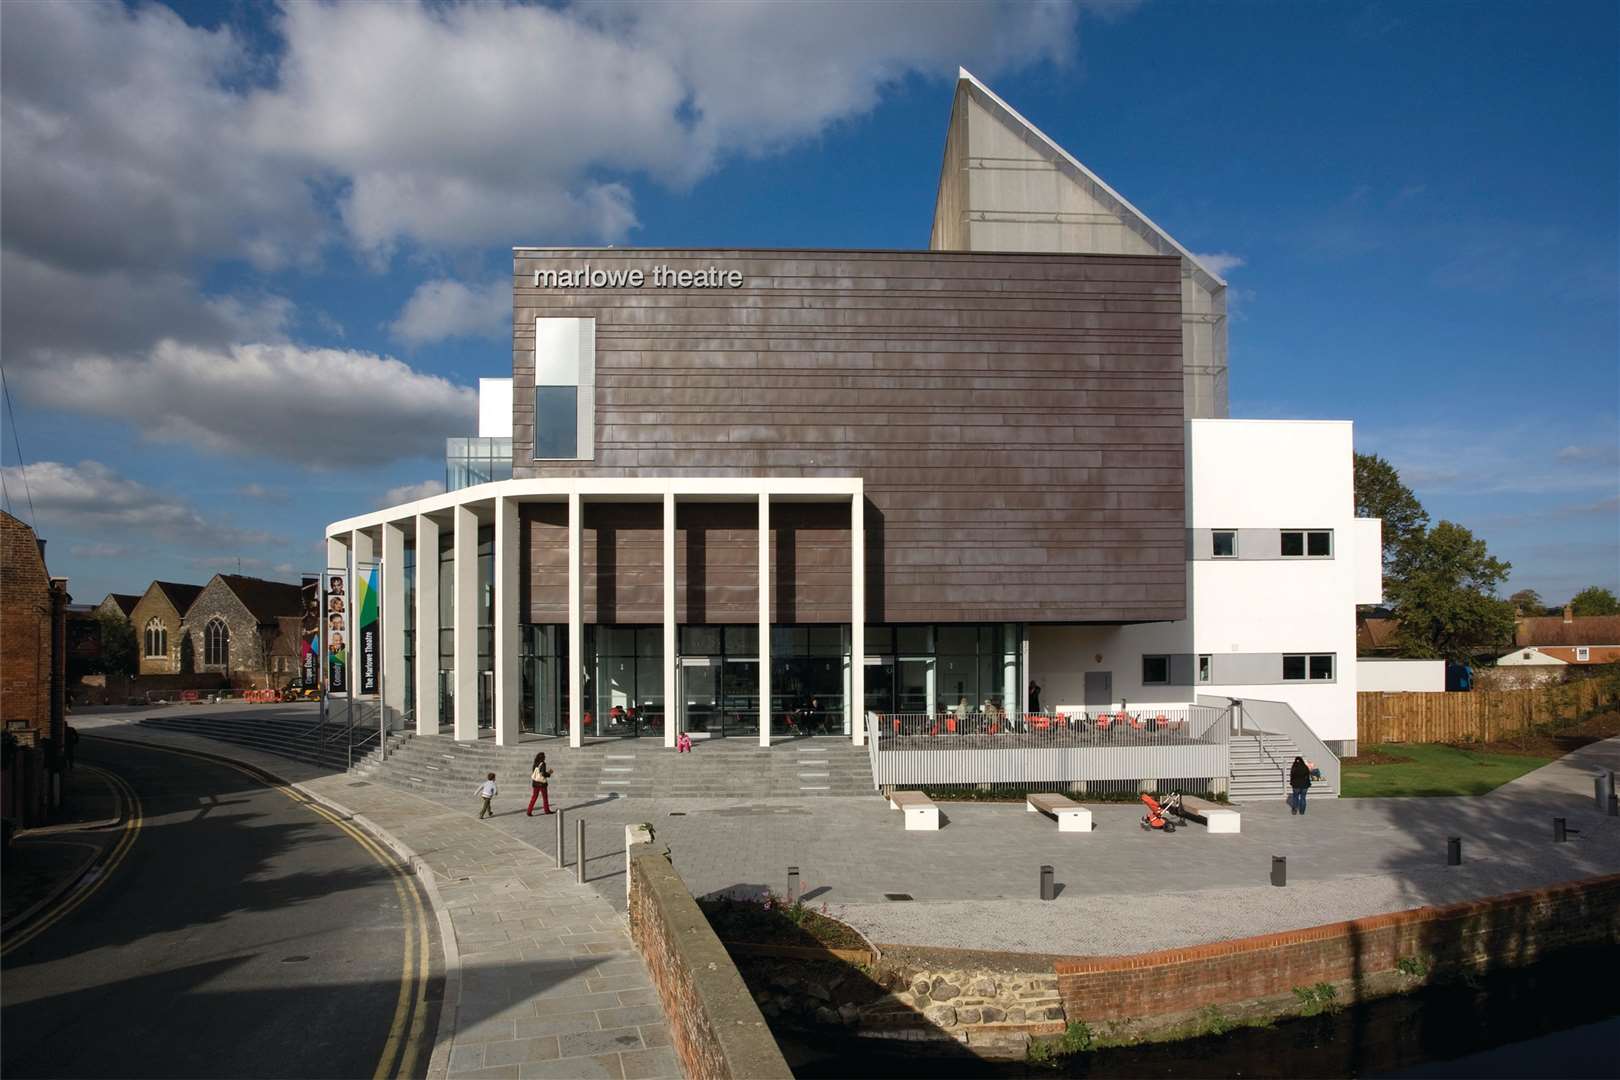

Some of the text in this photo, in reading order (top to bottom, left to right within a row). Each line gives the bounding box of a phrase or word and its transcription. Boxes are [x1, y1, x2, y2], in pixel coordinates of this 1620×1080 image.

[534, 263, 743, 288] marlowe theatre
[365, 632, 373, 689] The Marlowe Theatre
